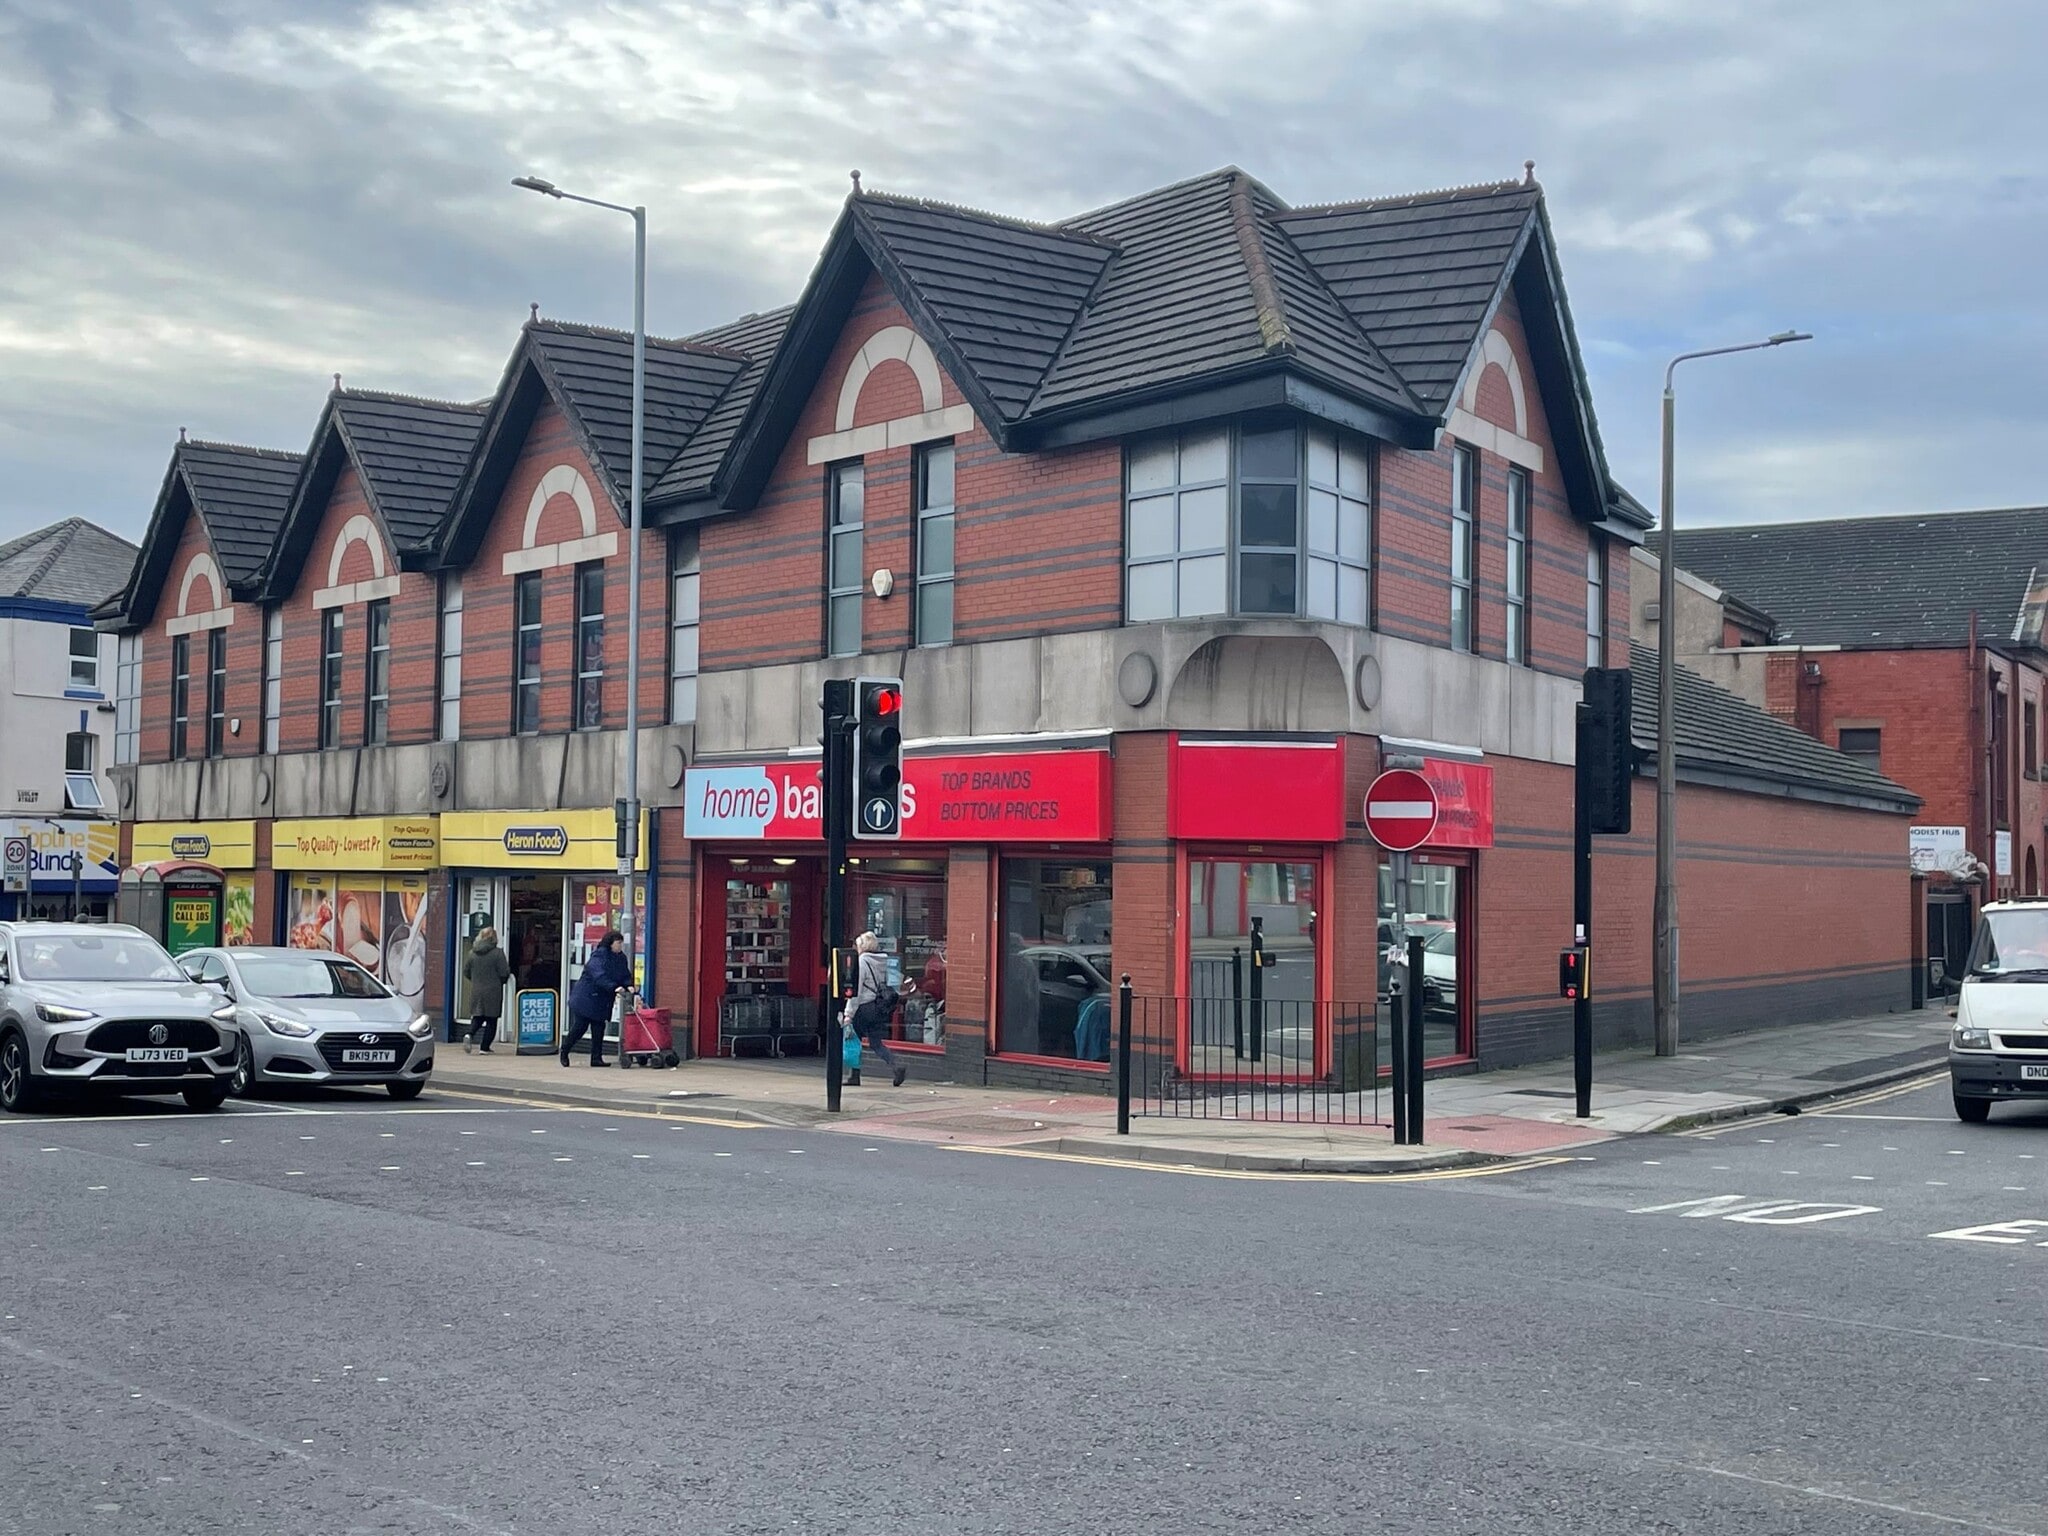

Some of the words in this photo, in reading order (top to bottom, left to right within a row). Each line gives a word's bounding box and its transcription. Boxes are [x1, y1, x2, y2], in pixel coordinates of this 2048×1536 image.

[942, 772, 968, 790] TOP
[972, 771, 1031, 790] BRANDS
[703, 780, 770, 818] home
[941, 802, 1000, 820] BOTTOM
[1005, 801, 1058, 820] PRICES
[394, 826, 405, 834] Top
[406, 825, 430, 835] Quality
[19, 826, 85, 850] Topline
[390, 839, 411, 847] Heron
[412, 839, 433, 848] Foods
[507, 832, 534, 848] Heron
[535, 832, 561, 848] Foods
[175, 840, 189, 852] Heron
[190, 840, 206, 852] Foods
[297, 837, 309, 855] Top
[311, 836, 338, 856] Quality
[344, 837, 370, 851] Lowest
[9, 848, 23, 857] 20
[30, 850, 83, 871] Blinds
[176, 912, 194, 921] CALL
[196, 912, 209, 921] 105
[522, 999, 551, 1009] FREE
[522, 1008, 551, 1018] CASH
[522, 1022, 550, 1032] HERE
[131, 1050, 160, 1060] LJ73
[163, 1050, 184, 1060] VED
[349, 1051, 370, 1061] BK19
[371, 1051, 390, 1061] RTY
[1627, 1195, 1884, 1224] NO
